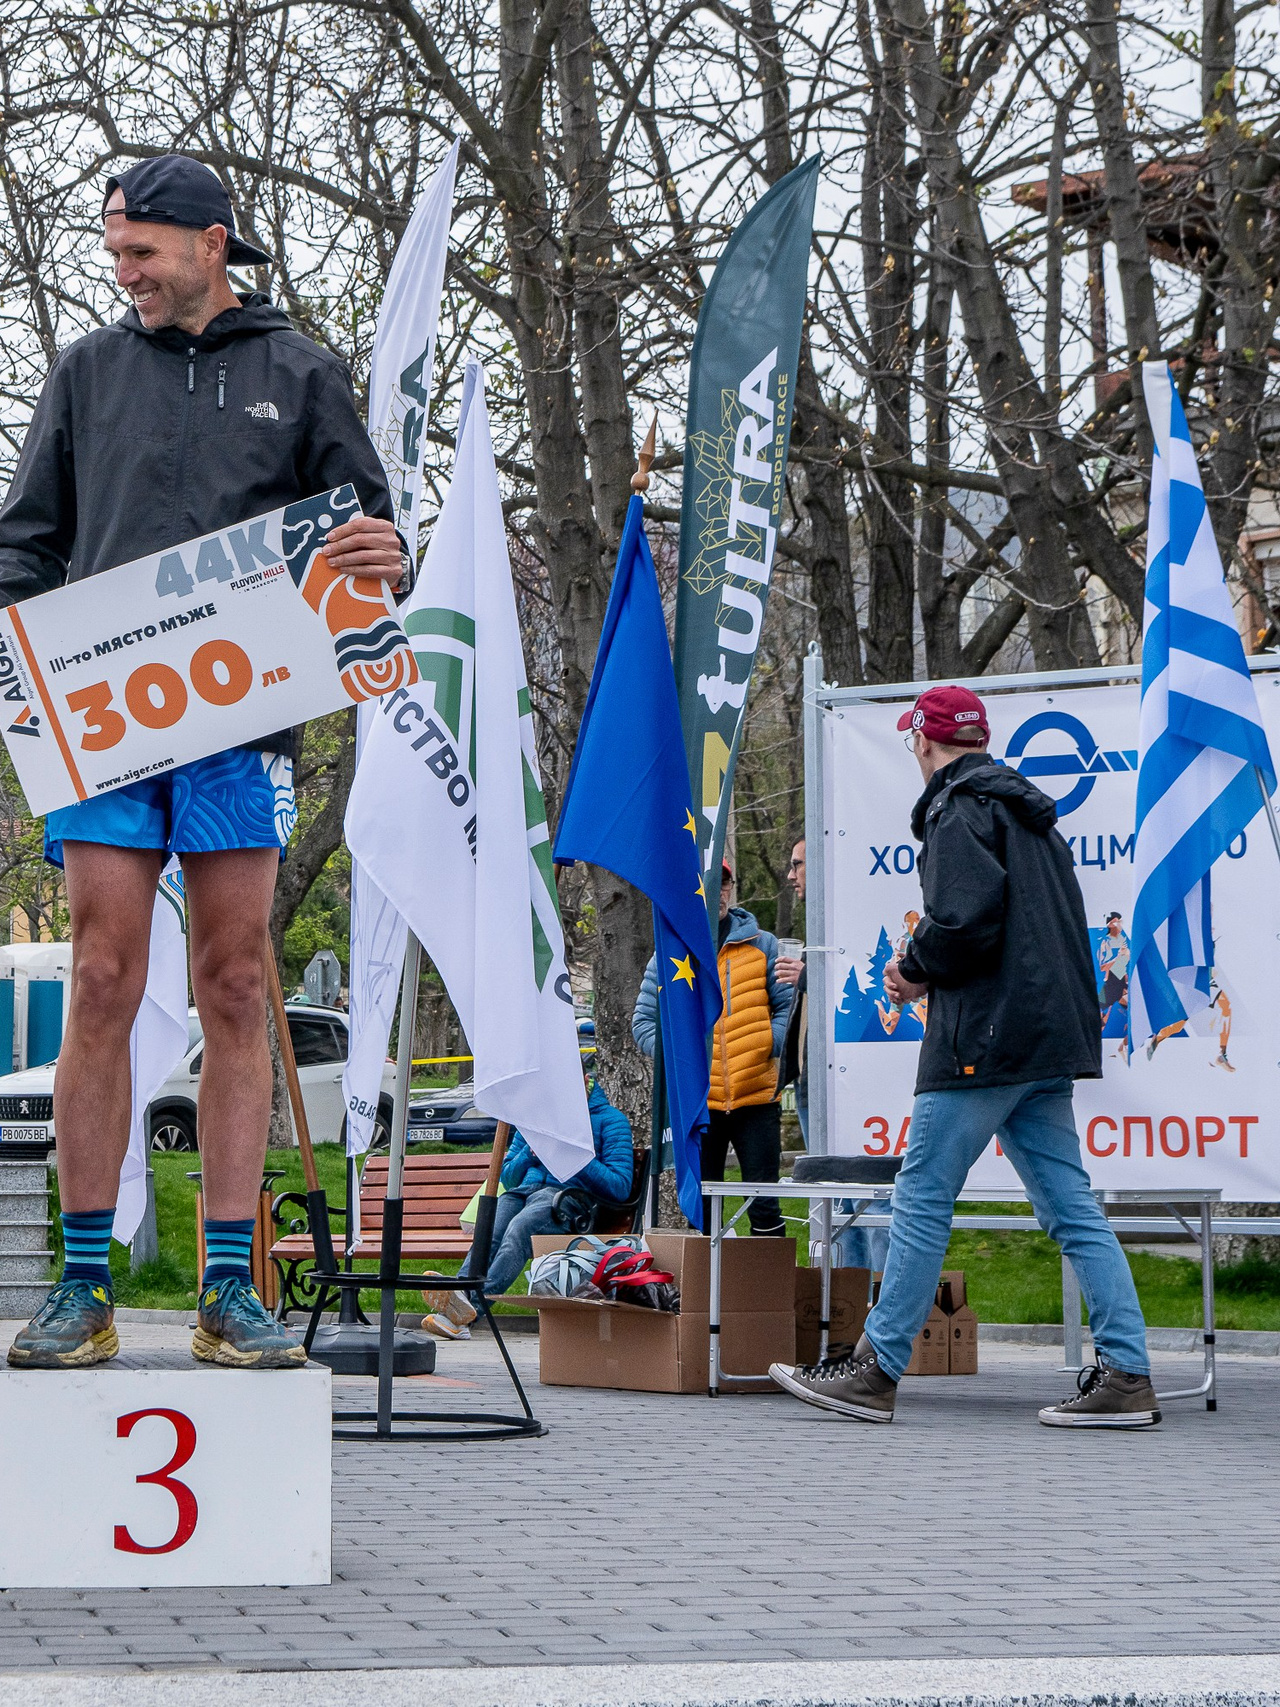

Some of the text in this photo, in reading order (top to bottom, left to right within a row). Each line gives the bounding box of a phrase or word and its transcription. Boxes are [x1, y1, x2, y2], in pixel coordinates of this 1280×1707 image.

[771, 373, 789, 516] BORDER RACE
[717, 346, 779, 656] ULTRA
[155, 519, 284, 598] 44K
[230, 564, 285, 591] PLOVDIV HILLS
[93, 625, 157, 657] МЯСТО
[159, 602, 218, 634] МЪЖЕ
[65, 639, 291, 752] 300 лв
[95, 757, 175, 791] www.aiger.com
[1086, 1115, 1259, 1158] СПОРТ
[113, 1407, 199, 1555] 3
